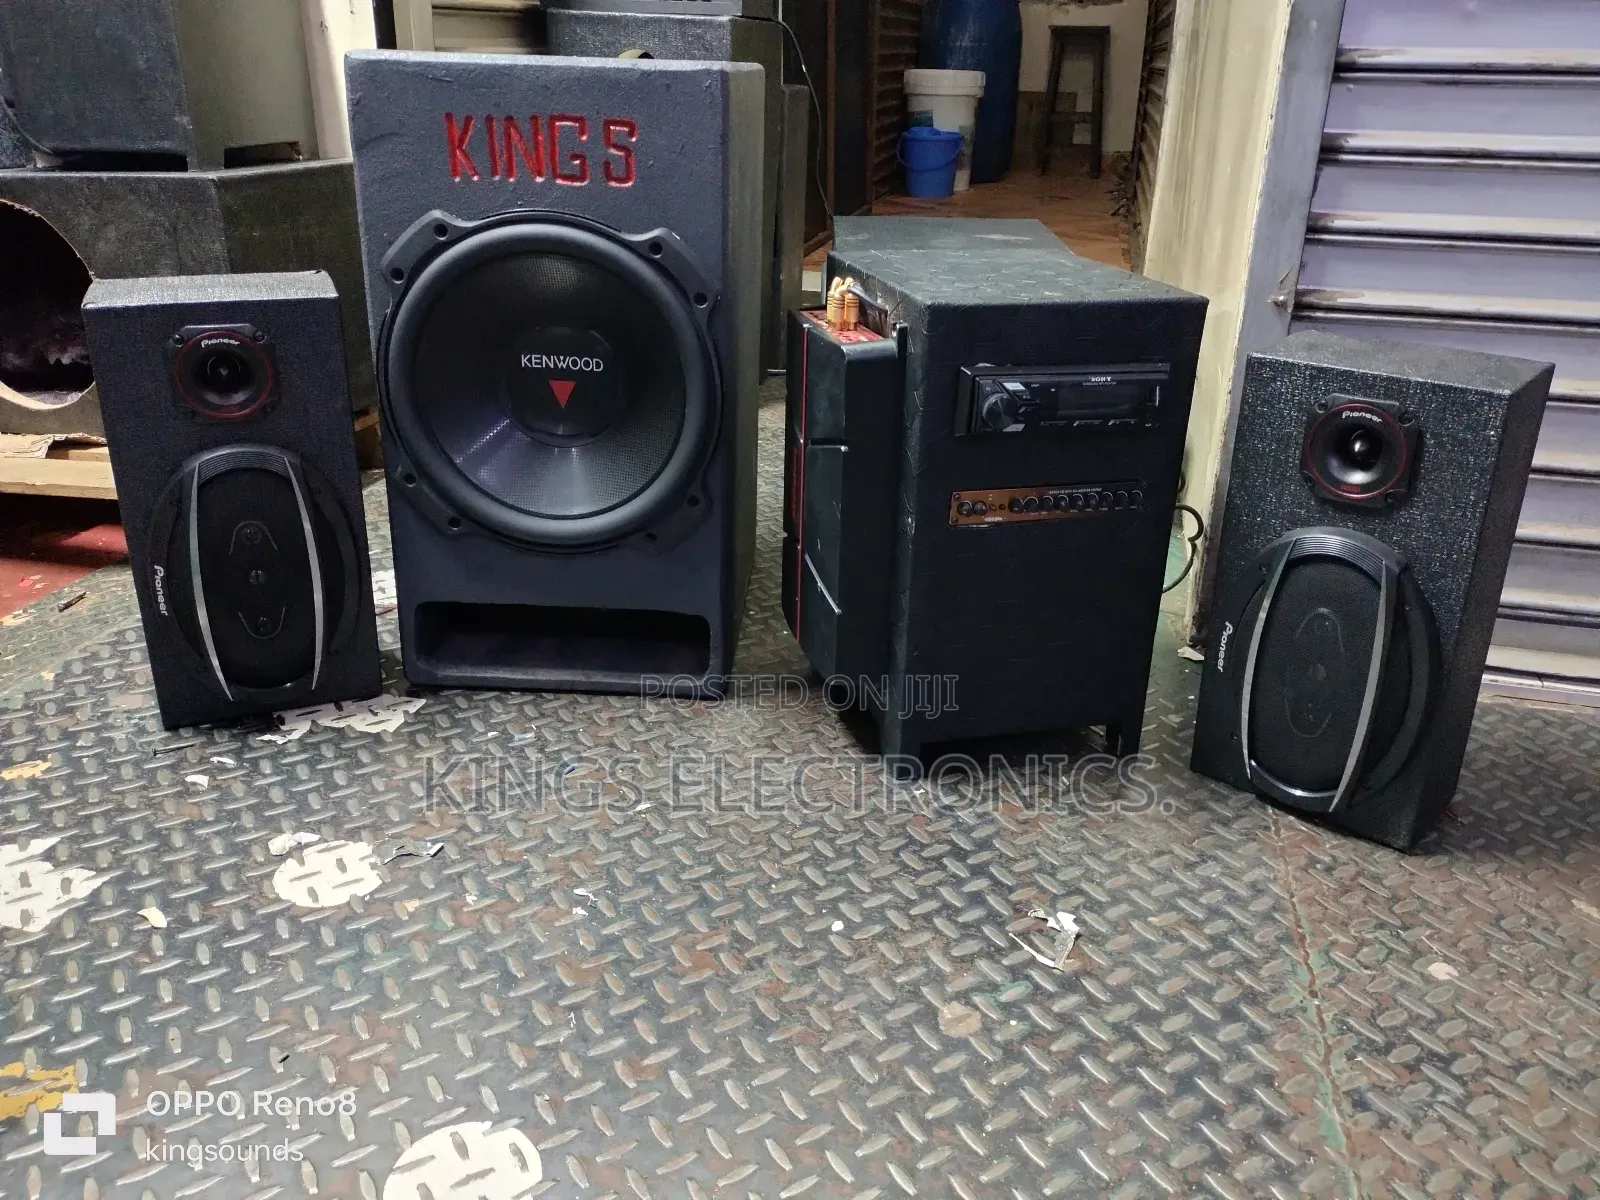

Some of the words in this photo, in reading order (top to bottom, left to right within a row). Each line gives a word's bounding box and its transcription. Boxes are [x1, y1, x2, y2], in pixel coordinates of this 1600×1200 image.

[444, 111, 638, 188] KINGS
[201, 338, 240, 348] Pioneer
[521, 354, 604, 372] KENWOOD
[1342, 410, 1382, 422] Pioneer
[154, 564, 168, 616] Pioneer
[1217, 621, 1233, 673] Pioneer
